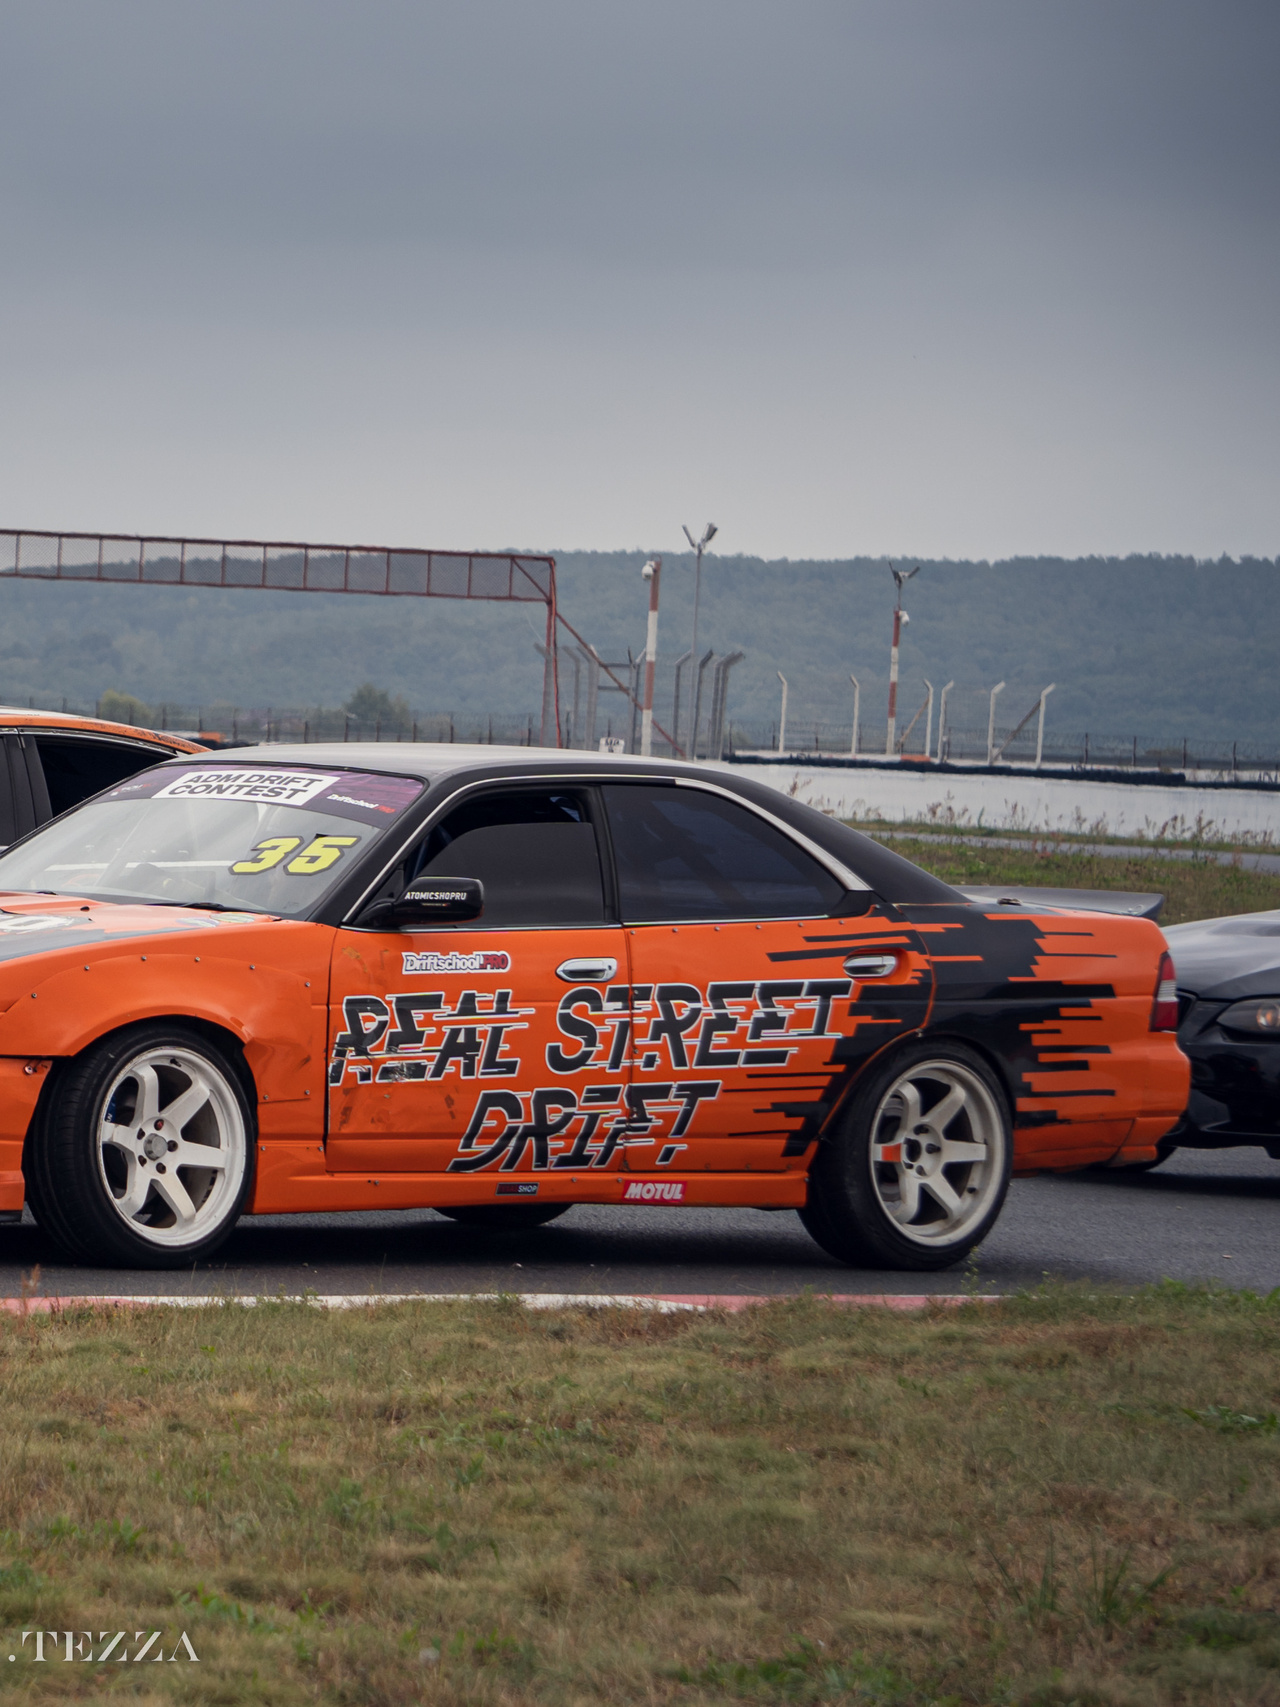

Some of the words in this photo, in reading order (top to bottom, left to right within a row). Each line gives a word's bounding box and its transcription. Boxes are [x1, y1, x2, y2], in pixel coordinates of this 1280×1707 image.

[168, 784, 309, 800] CONTEST
[183, 774, 245, 785] ADM
[243, 774, 323, 789] DRIFT
[227, 835, 362, 876] 35
[328, 989, 535, 1086] REAL
[545, 979, 854, 1075] STREET
[446, 1080, 723, 1173] DRIFT
[624, 1182, 683, 1200] MOTUL
